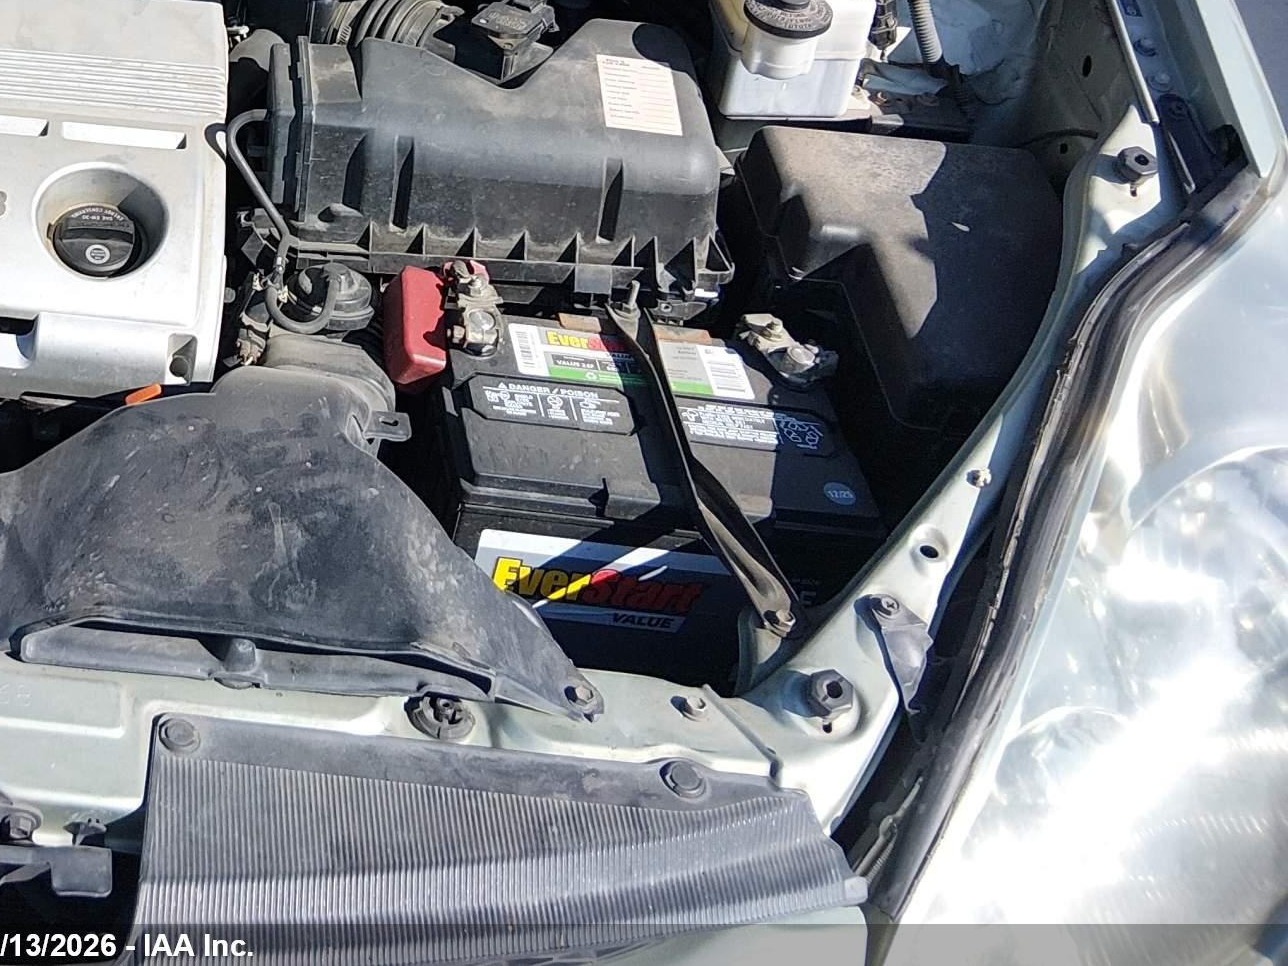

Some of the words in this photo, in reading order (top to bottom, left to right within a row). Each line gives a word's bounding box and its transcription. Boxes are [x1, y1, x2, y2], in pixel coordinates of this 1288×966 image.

[547, 331, 626, 352] EverS
[508, 383, 550, 394] DANGER
[560, 388, 599, 399] POISON
[492, 556, 702, 613] EverStart
[612, 612, 676, 628] VALUE
